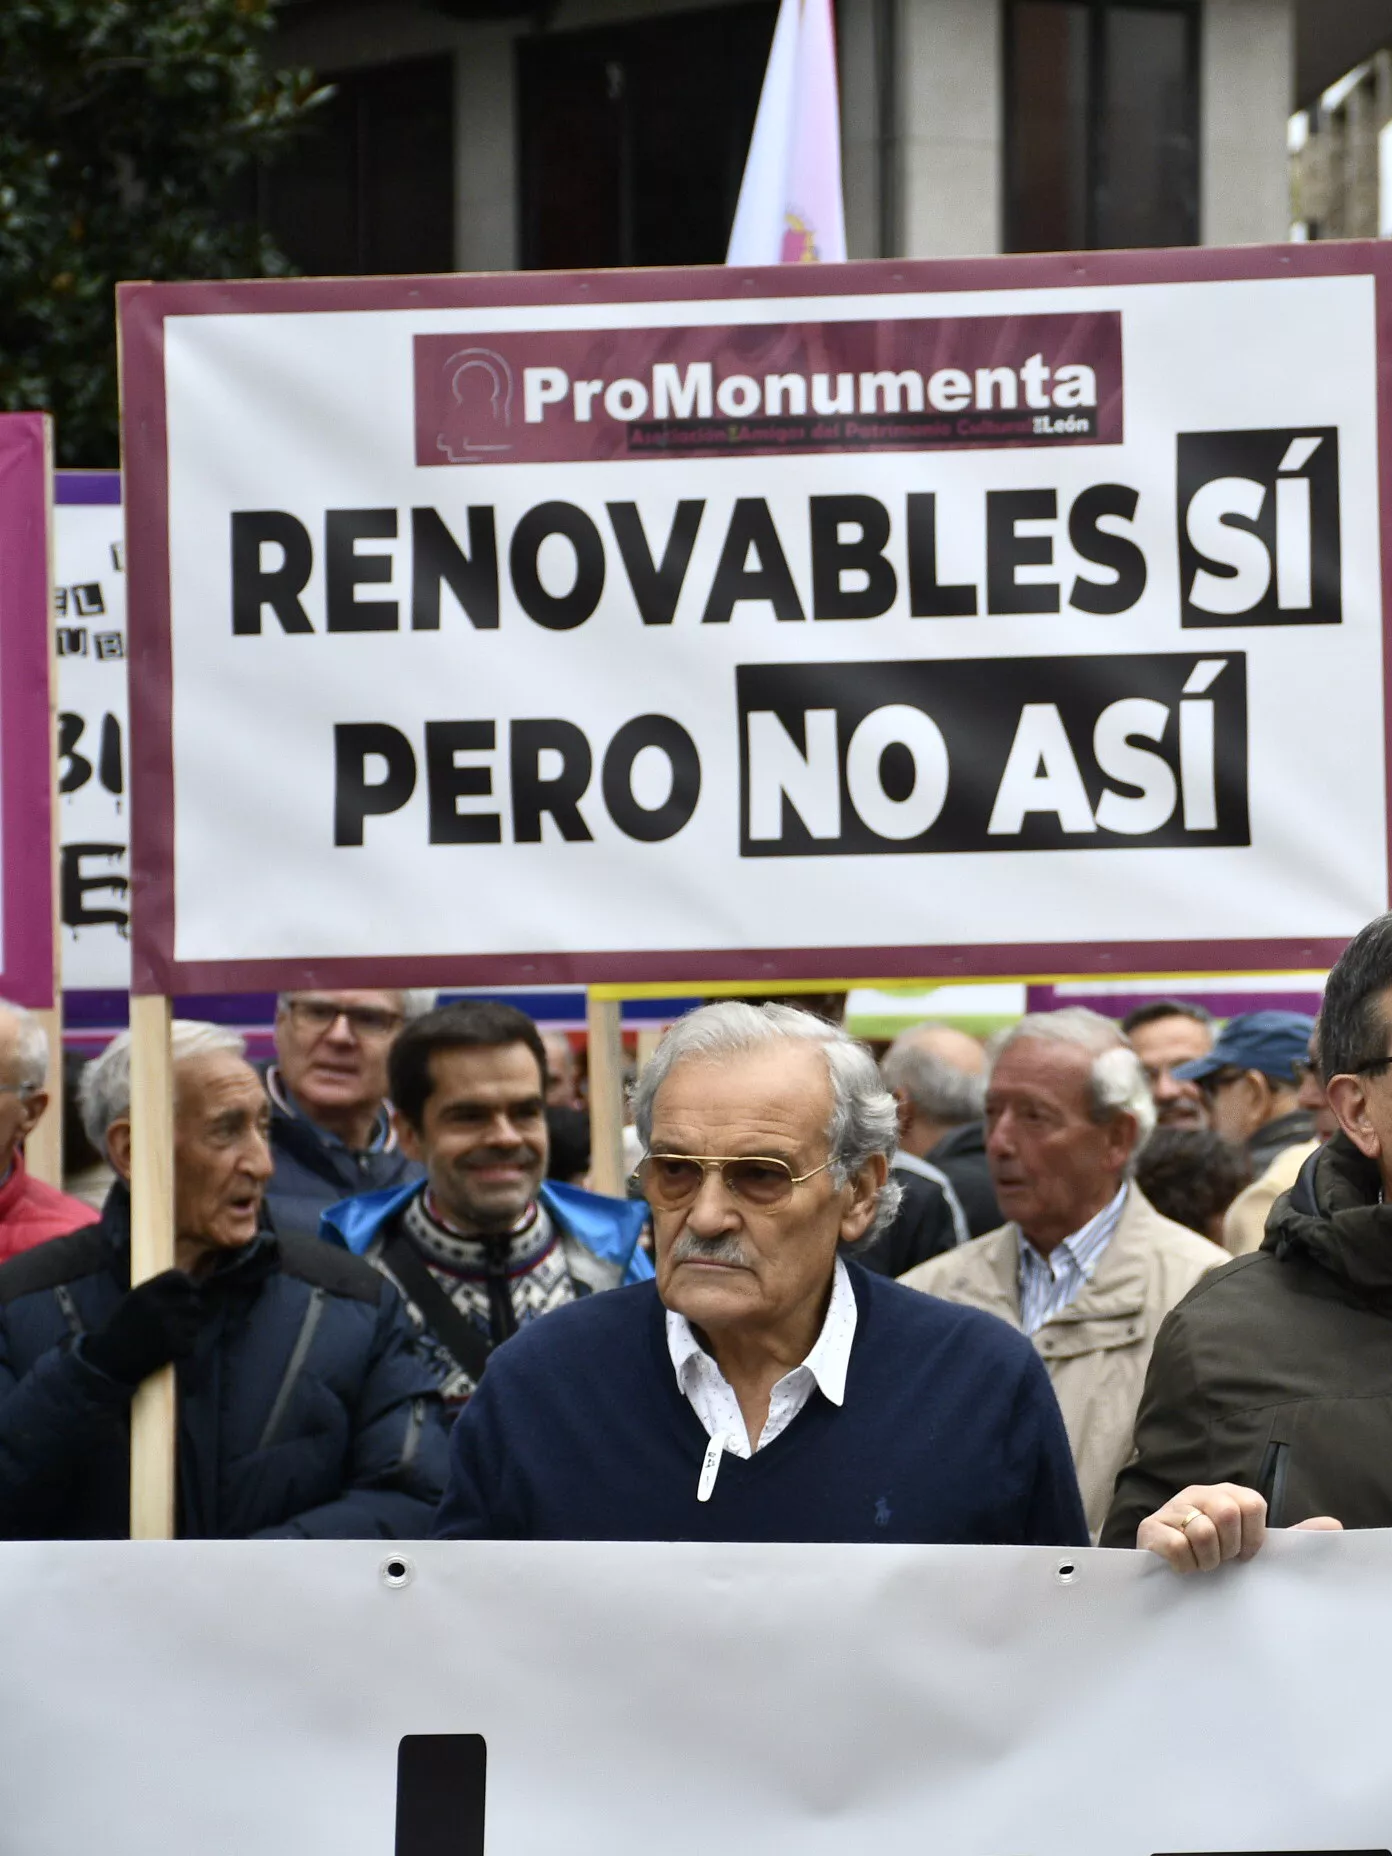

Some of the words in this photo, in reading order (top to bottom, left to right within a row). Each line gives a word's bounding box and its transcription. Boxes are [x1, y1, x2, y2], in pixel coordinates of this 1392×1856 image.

[524, 353, 1098, 424] ProMonumenta
[231, 483, 1147, 636] RENOVABLES
[1186, 439, 1323, 615] SÍ
[334, 713, 701, 847] PERO
[747, 704, 950, 840] NO
[987, 660, 1229, 836] ASÍ
